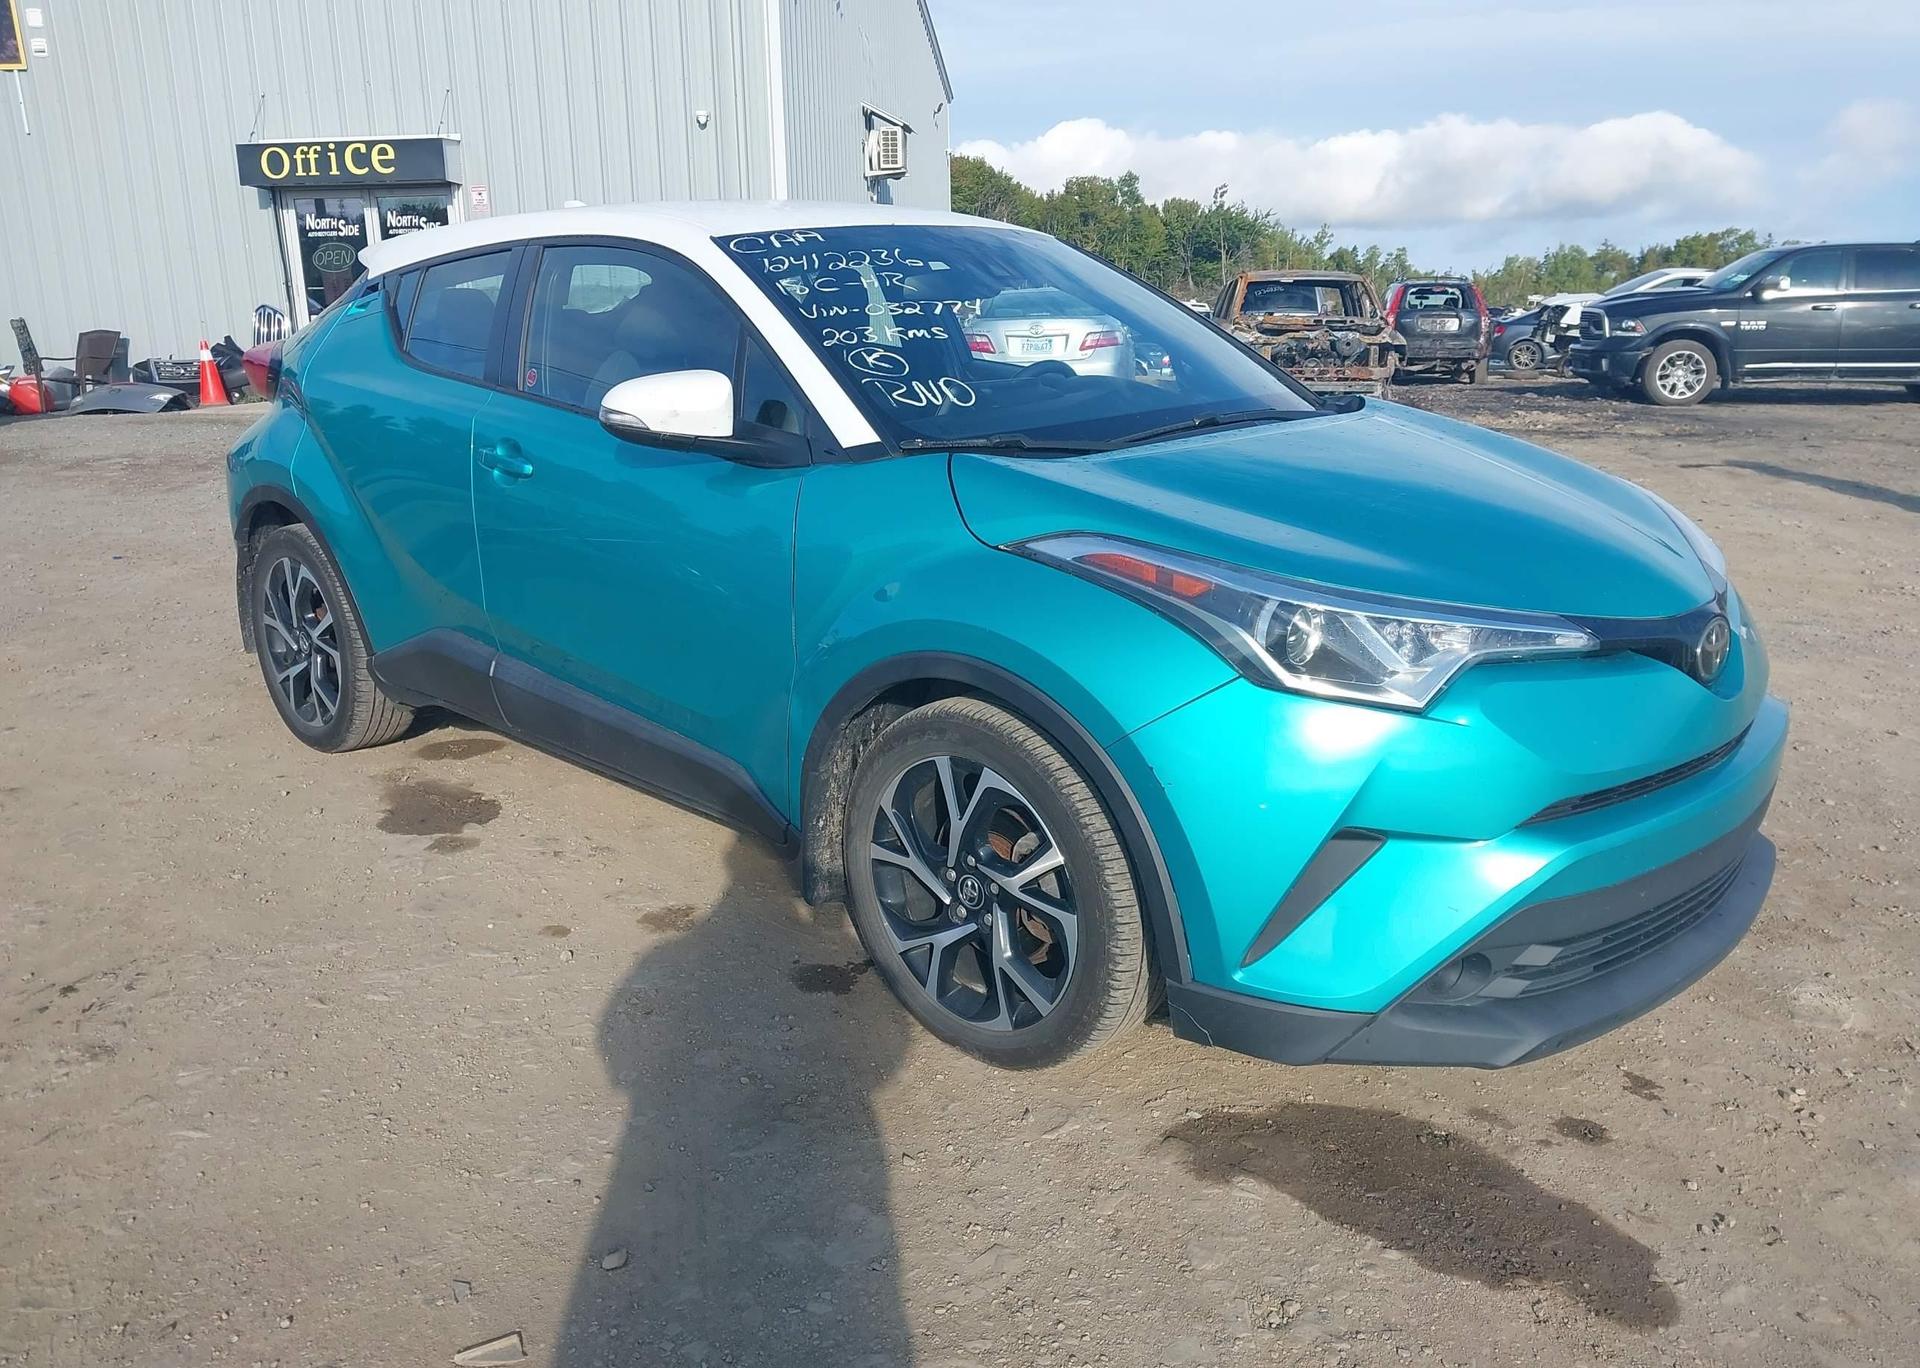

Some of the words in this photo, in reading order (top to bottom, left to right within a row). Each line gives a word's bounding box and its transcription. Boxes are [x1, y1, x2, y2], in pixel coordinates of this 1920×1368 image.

[260, 142, 396, 179] Office
[305, 213, 337, 230] NORTH
[338, 219, 360, 237] SIDE
[387, 210, 419, 227] NORTH
[729, 230, 826, 254] CAA
[315, 250, 351, 266] OPEN
[762, 248, 924, 273] 12412236
[822, 328, 879, 347] 203
